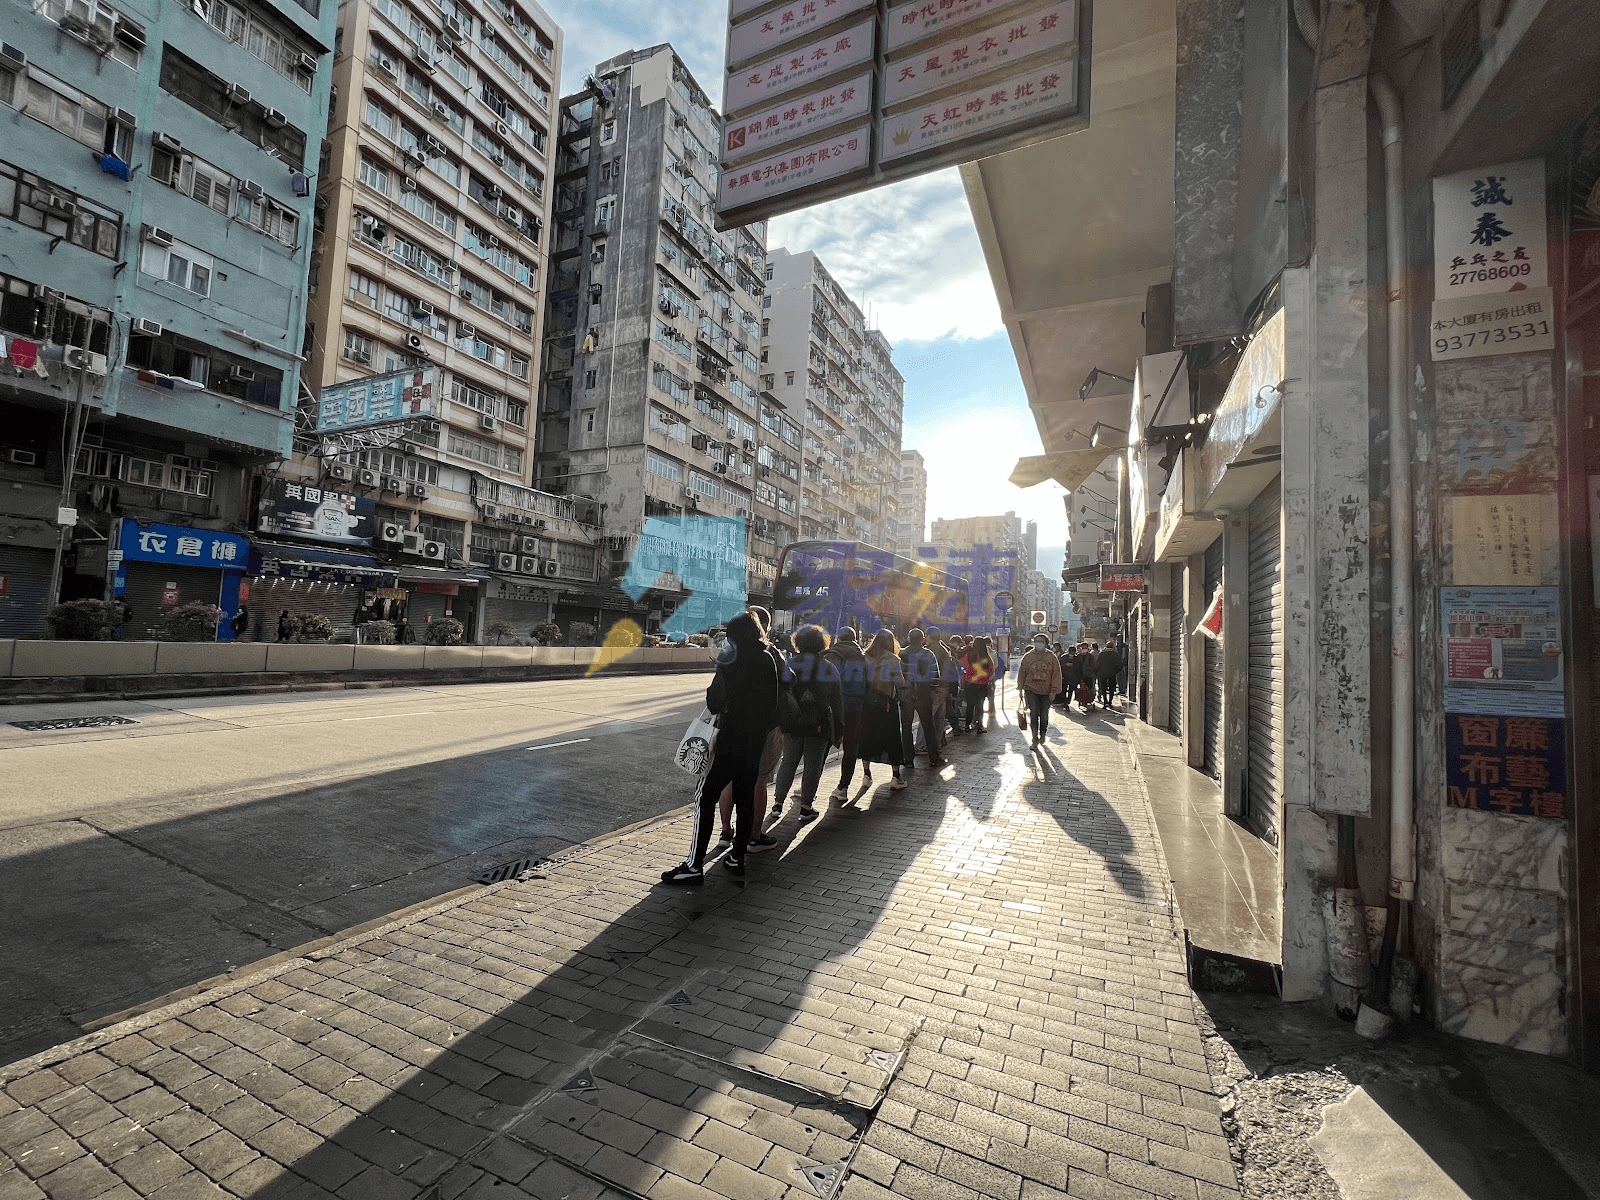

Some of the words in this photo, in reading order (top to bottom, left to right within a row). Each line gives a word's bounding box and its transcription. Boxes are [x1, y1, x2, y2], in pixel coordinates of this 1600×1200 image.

[746, 37, 852, 87] 志成製衣廠
[897, 13, 1060, 82] 天星製衣批發
[747, 87, 856, 136] 錦龍時裝批發
[919, 73, 1060, 129] 天虹時裝批發
[1469, 176, 1513, 246] 誠泰
[1449, 263, 1531, 286] 27768609
[1432, 302, 1543, 331] 本大廈有房出租
[1435, 320, 1550, 353] 93773531
[138, 531, 237, 561] 衣倉褲
[816, 586, 829, 596] 45
[1459, 752, 1551, 790] 布藝
